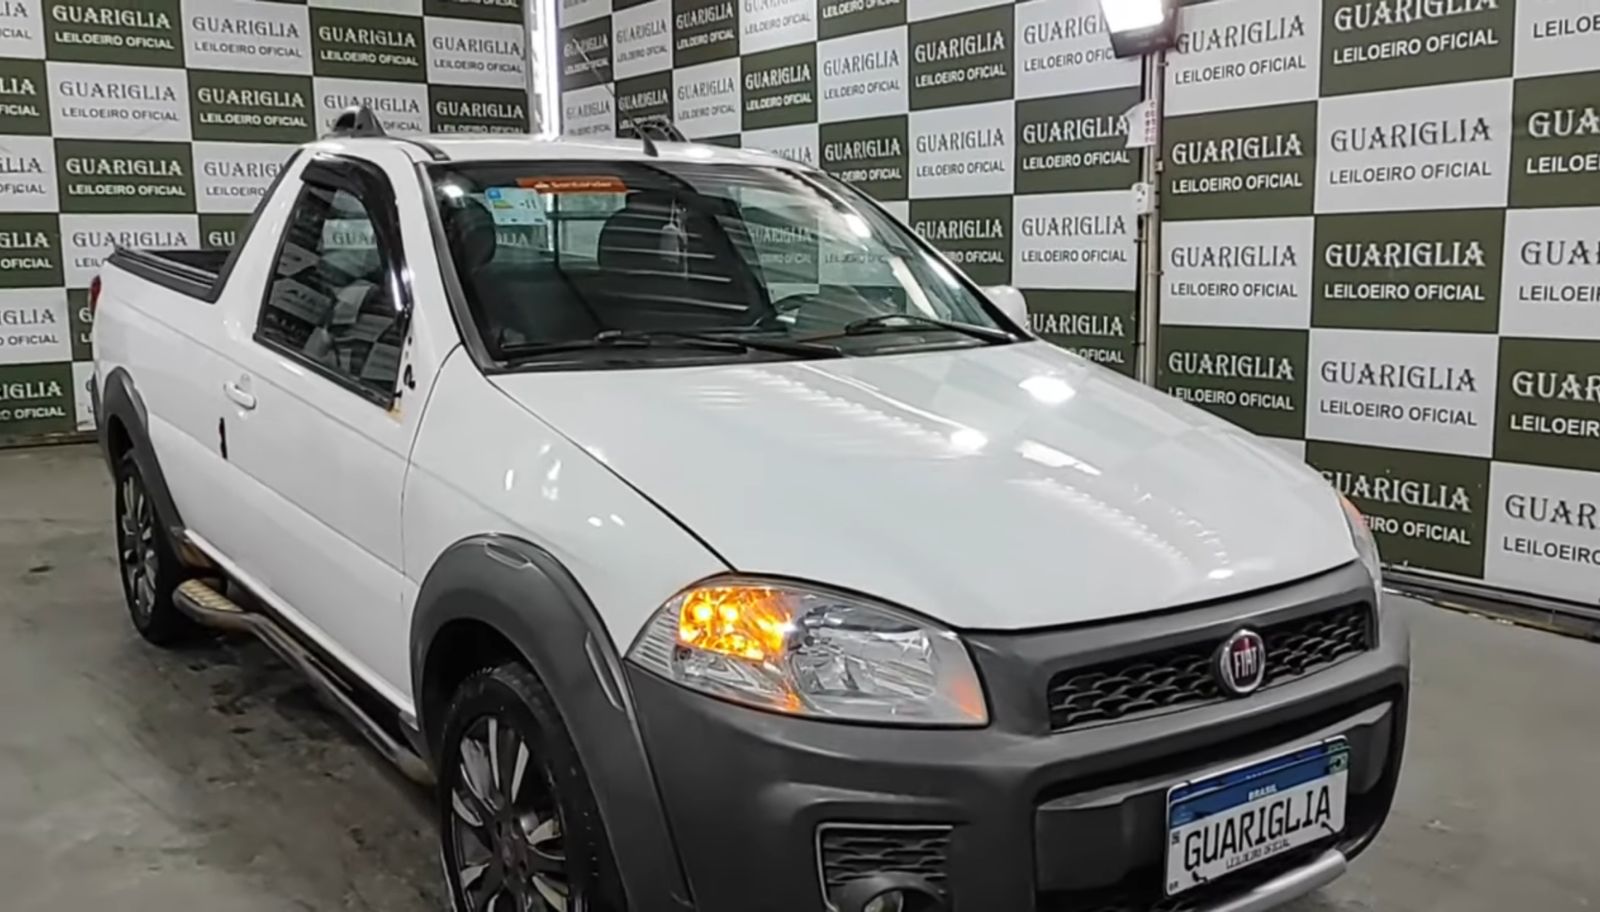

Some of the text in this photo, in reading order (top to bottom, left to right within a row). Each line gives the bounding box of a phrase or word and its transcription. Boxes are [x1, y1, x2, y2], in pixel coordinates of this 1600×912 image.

[52, 5, 171, 30] GUARIGLIA
[676, 3, 734, 30] GUARIGLIA
[1334, 0, 1498, 31] GUARIGLIA
[192, 16, 299, 39] GUARIGLIA
[319, 26, 417, 48] GUARIGLIA
[1175, 15, 1305, 55] GUARIGLIA
[55, 31, 175, 49] LEILOEIRO OFICIAL
[194, 41, 302, 58] LEILOEIRO OFICIAL
[432, 36, 522, 56] GUARIGLIA
[914, 30, 1005, 64] GUARIGLIA
[1333, 29, 1499, 65] LEILOEIRO OFICIAL
[321, 50, 419, 66] LEILOEIRO OFICIAL
[434, 59, 522, 74] LEILOEIRO OFICIAL
[823, 49, 899, 76] GUARIGLIA
[1024, 51, 1083, 72] LEILOEIRO
[745, 64, 811, 90] GUARIGLIA
[915, 64, 1007, 88] LEILOEIRO OFICIAL
[1175, 55, 1307, 85] LEILOEIRO OFICIAL
[59, 81, 177, 101] GUARIGLIA
[198, 88, 304, 108] GUARIGLIA
[677, 76, 735, 101] GUARIGLIA
[824, 79, 900, 100] LEILOEIRO OFICIAL
[436, 100, 524, 119] GUARIGLIA
[746, 92, 812, 111] LEILOEIRO OFICIAL
[62, 107, 180, 122] LEILOEIRO OFICIAL
[200, 113, 308, 128] LEILOEIRO OFICIAL
[1023, 114, 1128, 144] GUARIGLIA
[1330, 117, 1493, 152] GUARIGLIA
[824, 138, 901, 161] GUARIGLIA
[916, 128, 1005, 153] GUARIGLIA
[1171, 134, 1303, 165] GUARIGLIA
[65, 158, 183, 177] GUARIGLIA
[916, 160, 1006, 178] LEILOEIRO OFICIAL
[1023, 150, 1130, 170] LEILOEIRO OFICIAL
[1526, 153, 1600, 174] LEILOE
[869, 168, 902, 180] OFICIAL
[1171, 172, 1303, 194] LEILOEIRO OFICIAL
[1329, 161, 1492, 185] LEILOEIRO OFICIAL
[68, 184, 186, 196] LEILOEIRO OFICIAL
[206, 186, 266, 197] LEILOEIRO
[915, 219, 1004, 240] GUARIGLIA
[1021, 215, 1126, 237] GUARIGLIA
[72, 231, 188, 247] GUARIGLIA
[1, 257, 53, 269] OFICIAL
[966, 250, 1004, 263] OFICIAL
[1021, 249, 1127, 262] LEILOEIRO OFICIAL
[1170, 245, 1297, 269] GUARIGLIA
[1324, 240, 1486, 269] GUARIGLIA
[1170, 282, 1298, 297] LEILOEIRO OFICIAL
[1324, 284, 1485, 301] LEILOEIRO OFICIAL
[8, 333, 58, 345] OFICIAL
[1168, 352, 1295, 381] GUARIGLIA
[1320, 360, 1477, 393] GUARIGLIA
[1169, 387, 1295, 410] LEILOEIRO OFICIAL
[15, 406, 65, 418] OFICIAL
[1320, 399, 1478, 426] LEILOEIRO OFICIAL
[1403, 521, 1471, 545] OFICIAL
[1233, 646, 1258, 679] FIAT
[1184, 785, 1331, 872] GUARIGLIA
